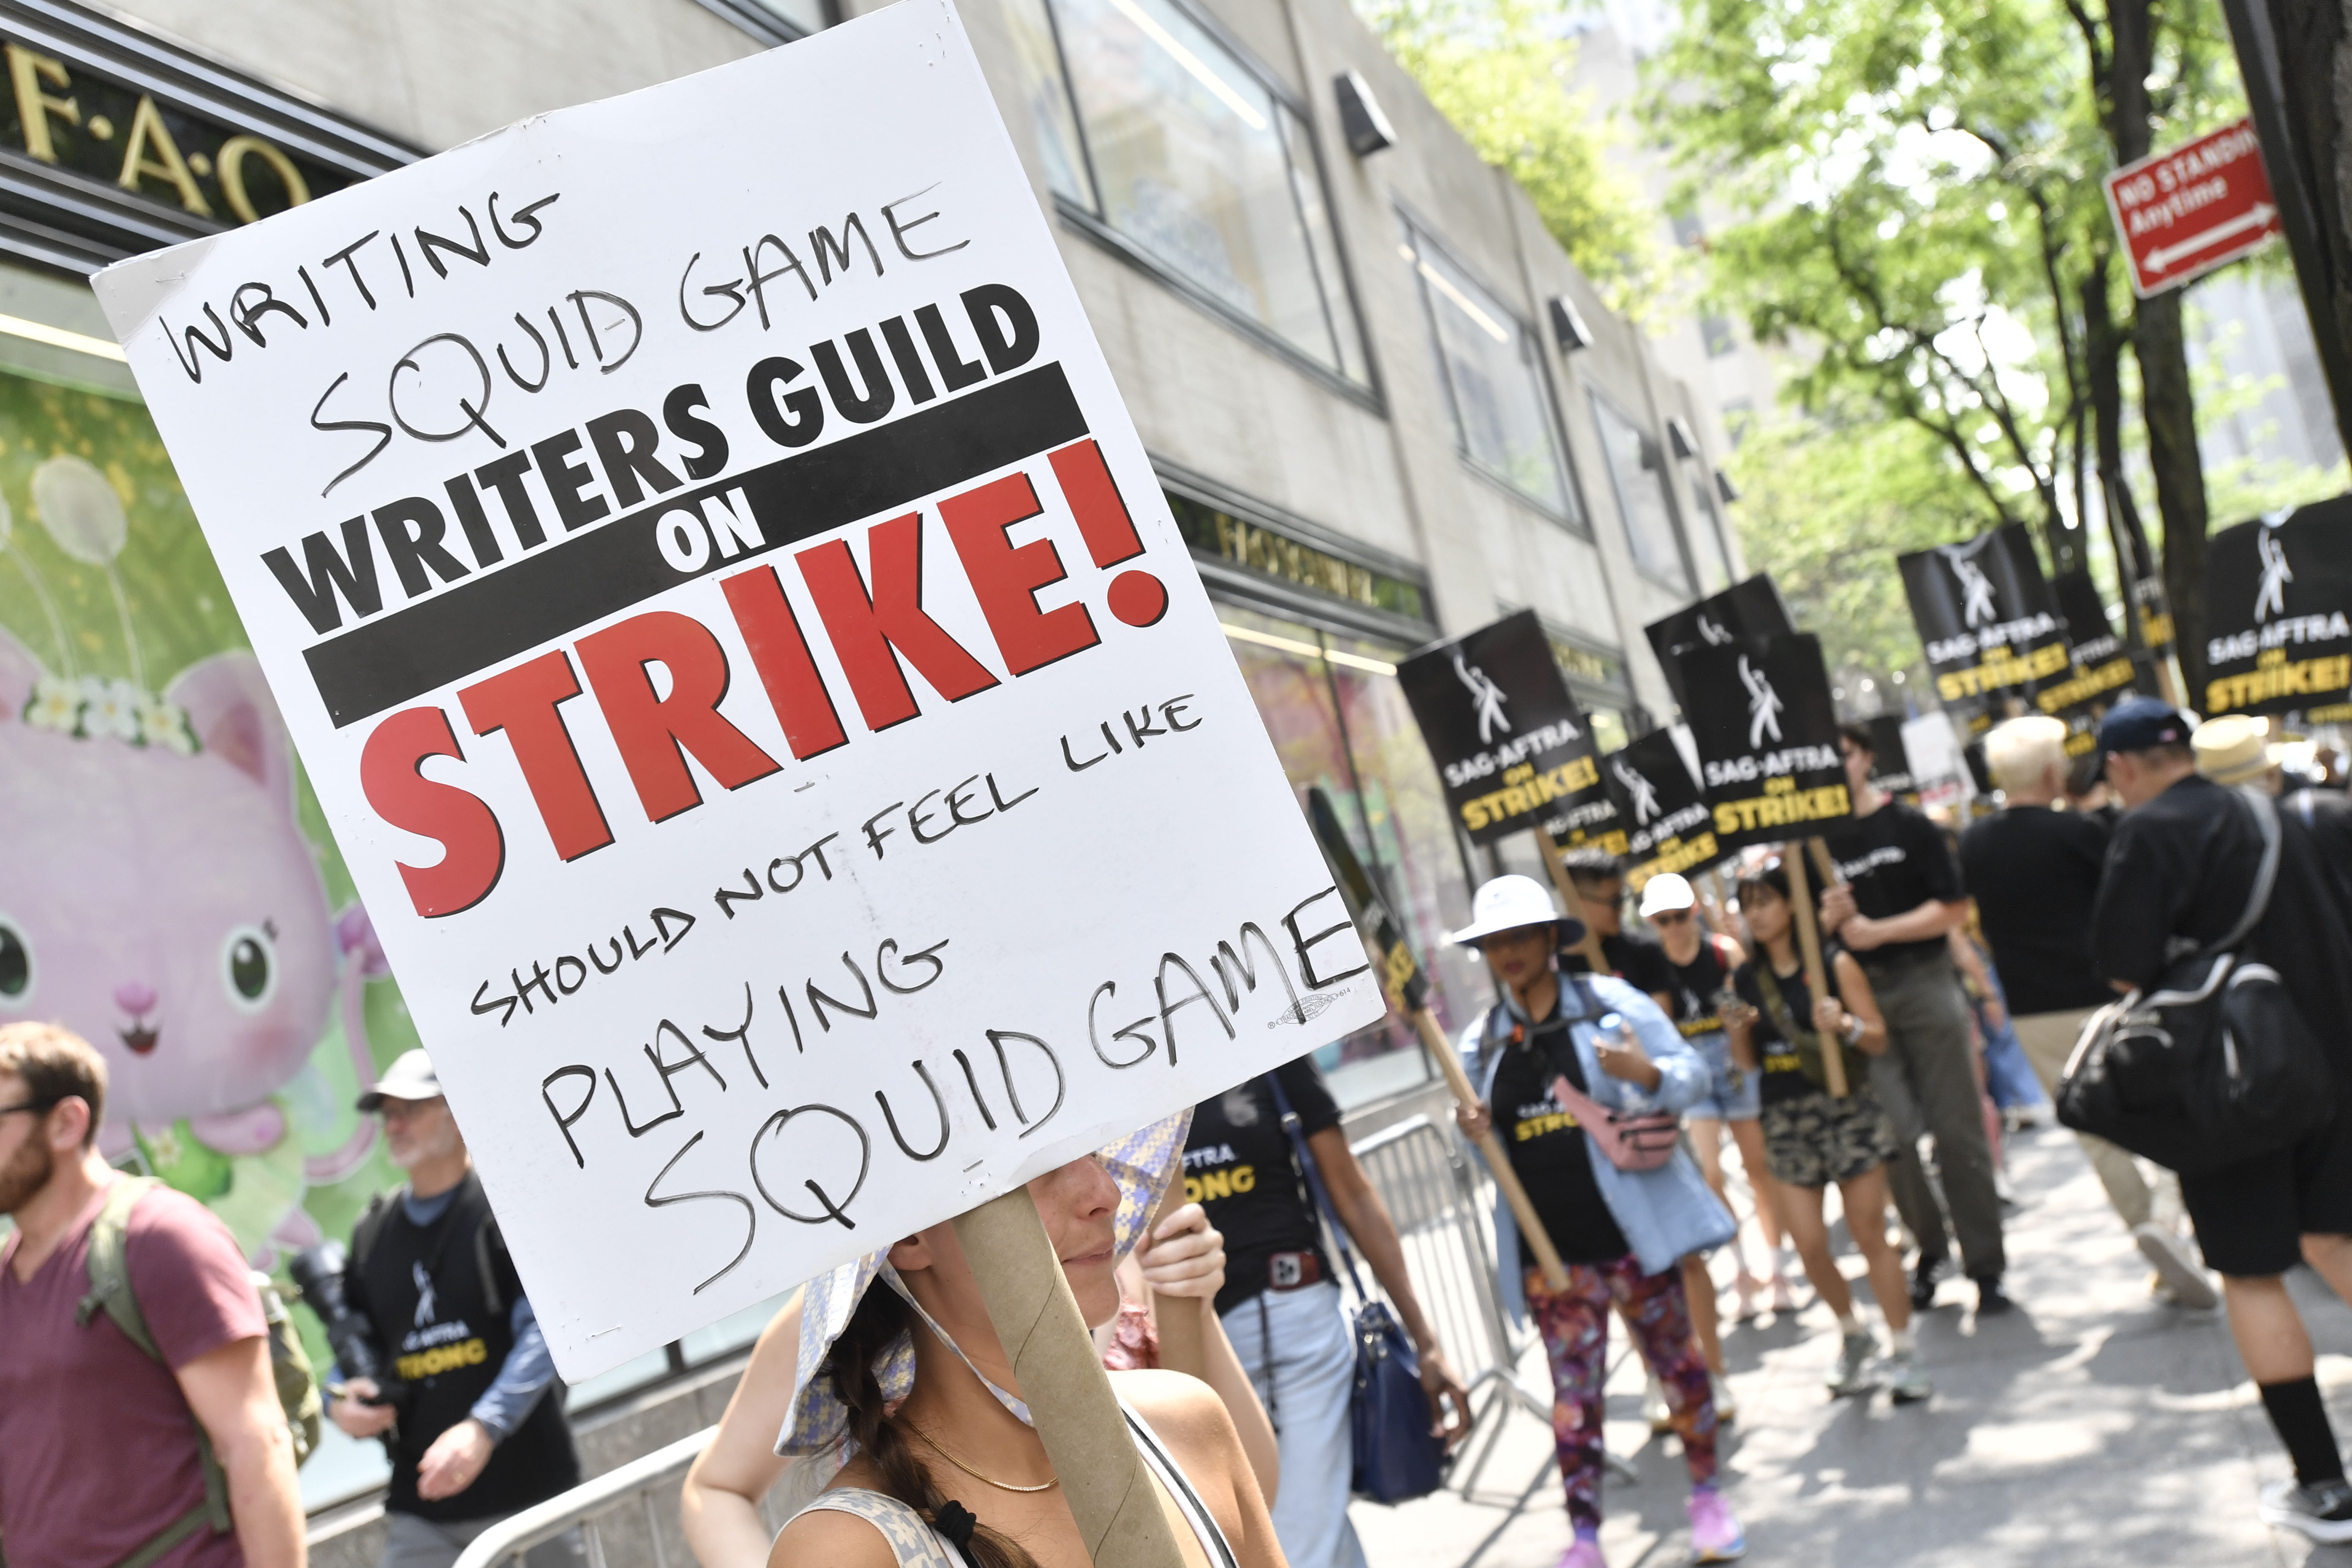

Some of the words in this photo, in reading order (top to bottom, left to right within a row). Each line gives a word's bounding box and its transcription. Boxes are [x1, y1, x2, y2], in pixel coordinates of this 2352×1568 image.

[2117, 173, 2155, 210] NO
[159, 191, 560, 384] WRITING
[310, 289, 642, 498] SQUID
[678, 182, 971, 331] GAME
[260, 383, 730, 635] WRITERS
[747, 283, 1040, 447] GUILD
[656, 486, 766, 573] ON
[360, 438, 1169, 918] STRIKE!
[1937, 642, 2069, 701] STRIKE!
[2206, 654, 2352, 713] STRIKE!
[1460, 755, 1600, 831] STRIKE!
[1503, 762, 1535, 787] ON
[1712, 784, 1851, 835] STRIKE!
[1763, 775, 1796, 795] ON
[470, 907, 696, 1028] SHOULD
[715, 831, 840, 920] NOT
[862, 772, 1039, 860] FEEL
[1060, 693, 1203, 772] LIKE
[1315, 996, 1336, 1007] COUNCIL
[1339, 988, 1350, 996] 614
[542, 936, 950, 1169] PLAYING
[645, 1029, 1064, 1295] SQUID
[1088, 885, 1370, 1069] GAME
